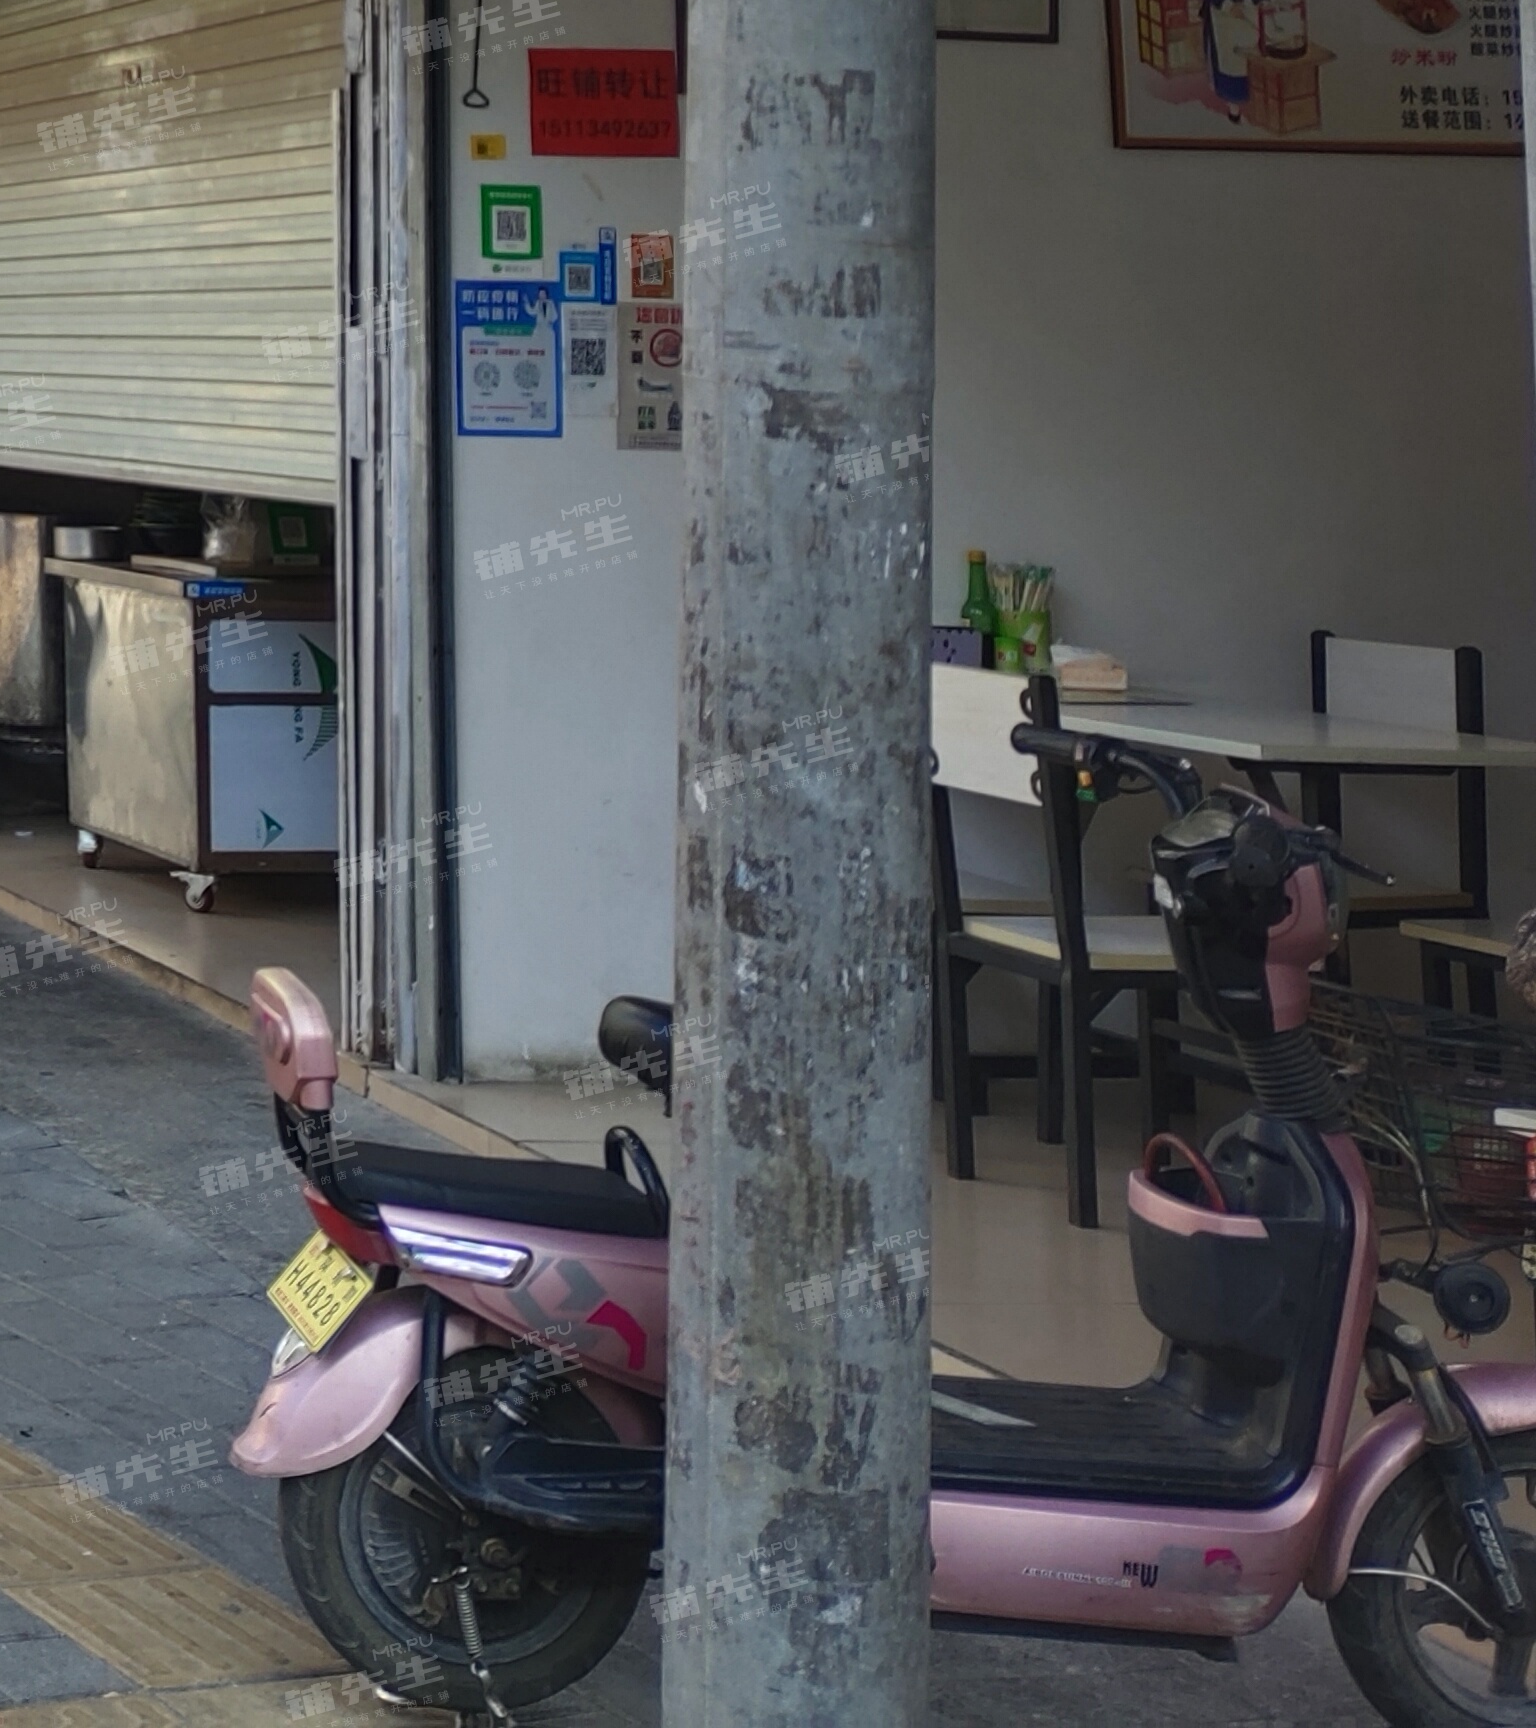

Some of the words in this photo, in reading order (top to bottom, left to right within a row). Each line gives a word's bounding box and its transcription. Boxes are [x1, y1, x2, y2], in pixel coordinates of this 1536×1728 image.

[536, 68, 669, 100] 旺铺转让
[284, 1258, 342, 1326] H44828
